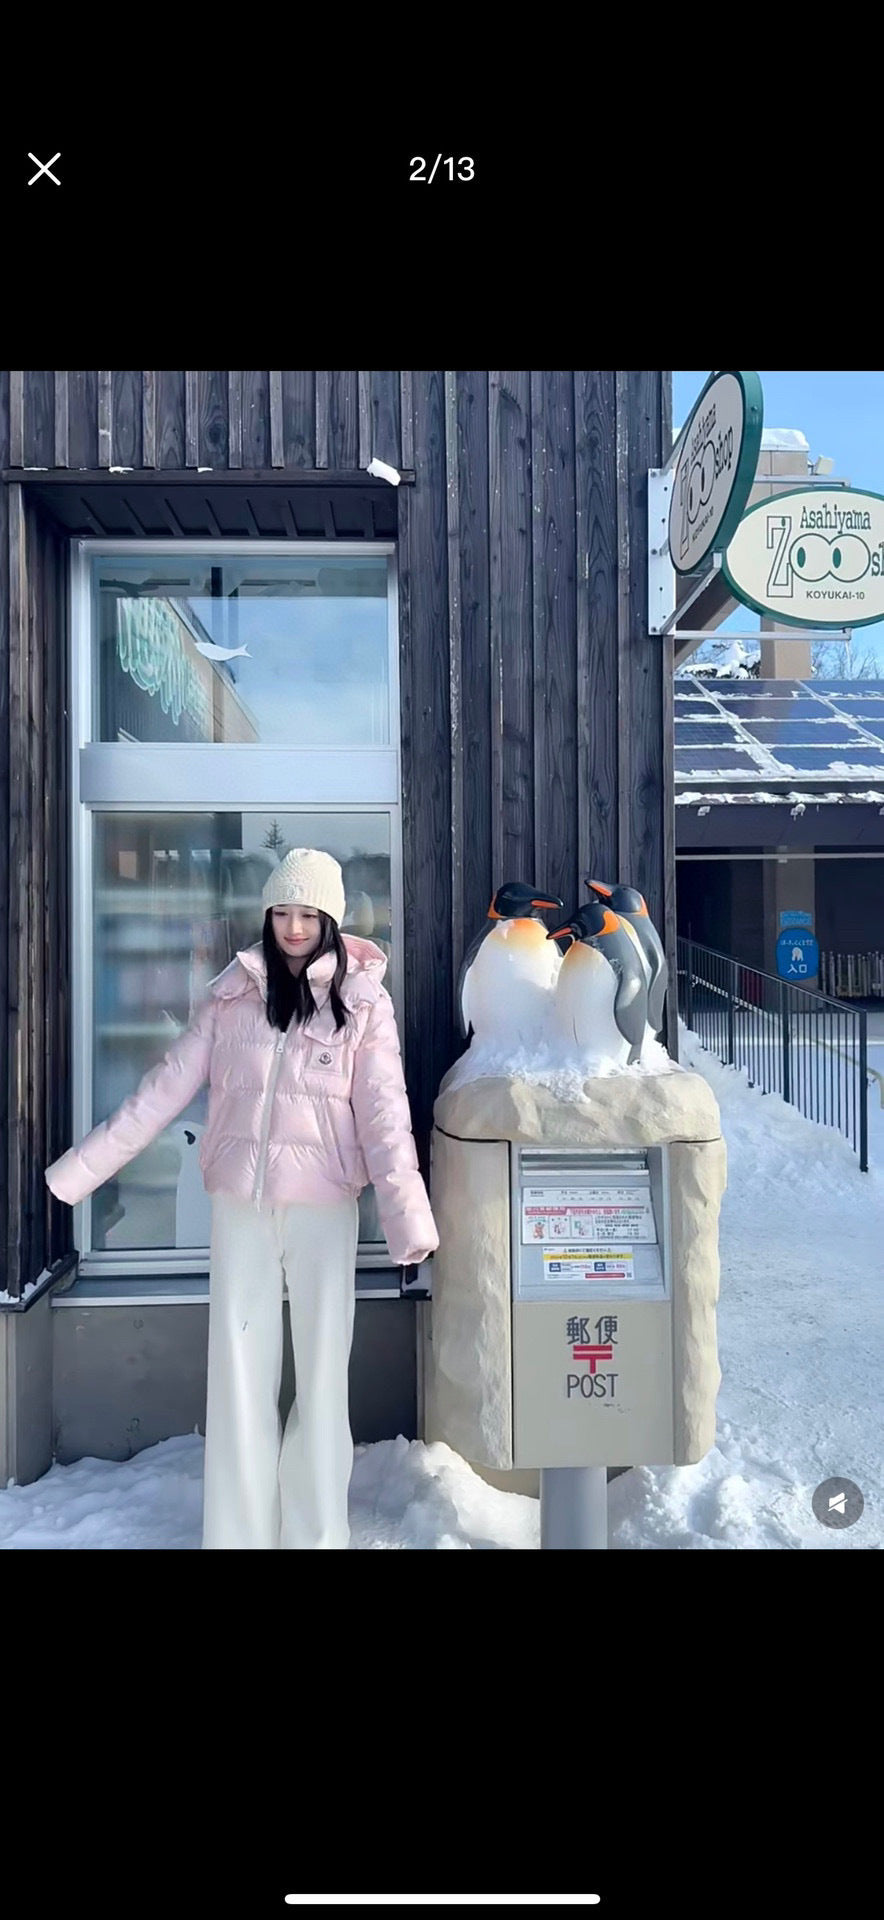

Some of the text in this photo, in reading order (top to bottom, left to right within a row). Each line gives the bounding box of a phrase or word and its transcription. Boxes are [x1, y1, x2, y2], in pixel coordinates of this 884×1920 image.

[799, 503, 872, 534] Asahiyama
[806, 590, 865, 600] KOYUKAI-10
[787, 963, 808, 974] 入口
[565, 1315, 619, 1345] 郵便
[566, 1373, 619, 1399] POST
